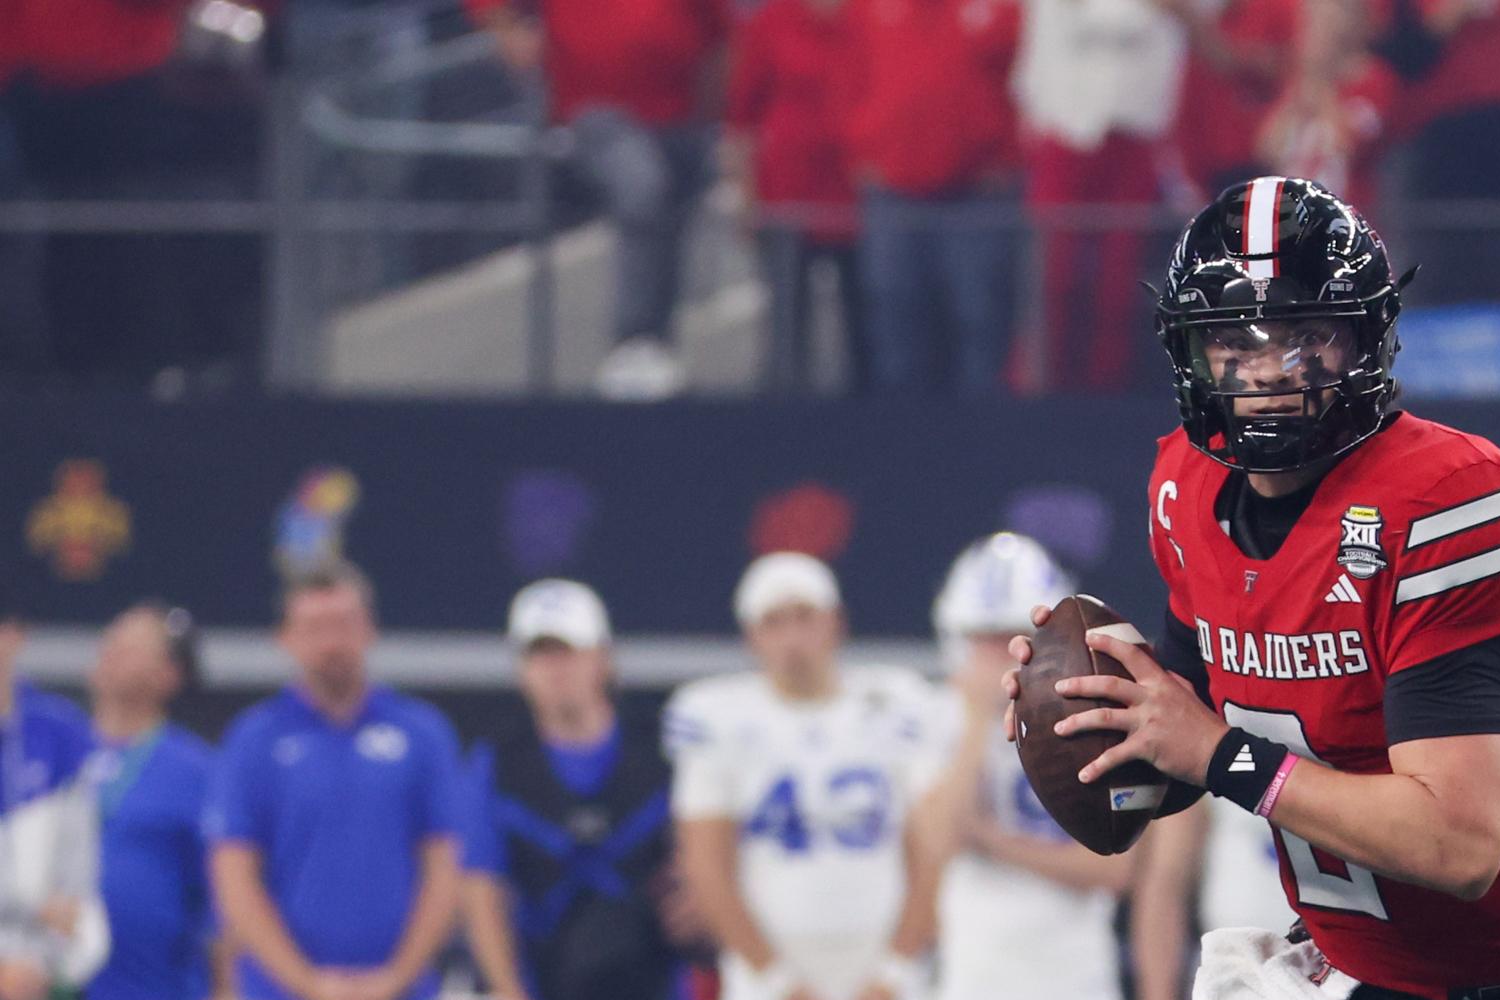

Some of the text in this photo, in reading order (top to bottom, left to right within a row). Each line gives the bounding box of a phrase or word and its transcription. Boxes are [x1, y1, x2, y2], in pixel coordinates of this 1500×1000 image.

[1157, 479, 1178, 531] C
[1341, 519, 1383, 551] XII
[1219, 627, 1368, 679] RAIDERS
